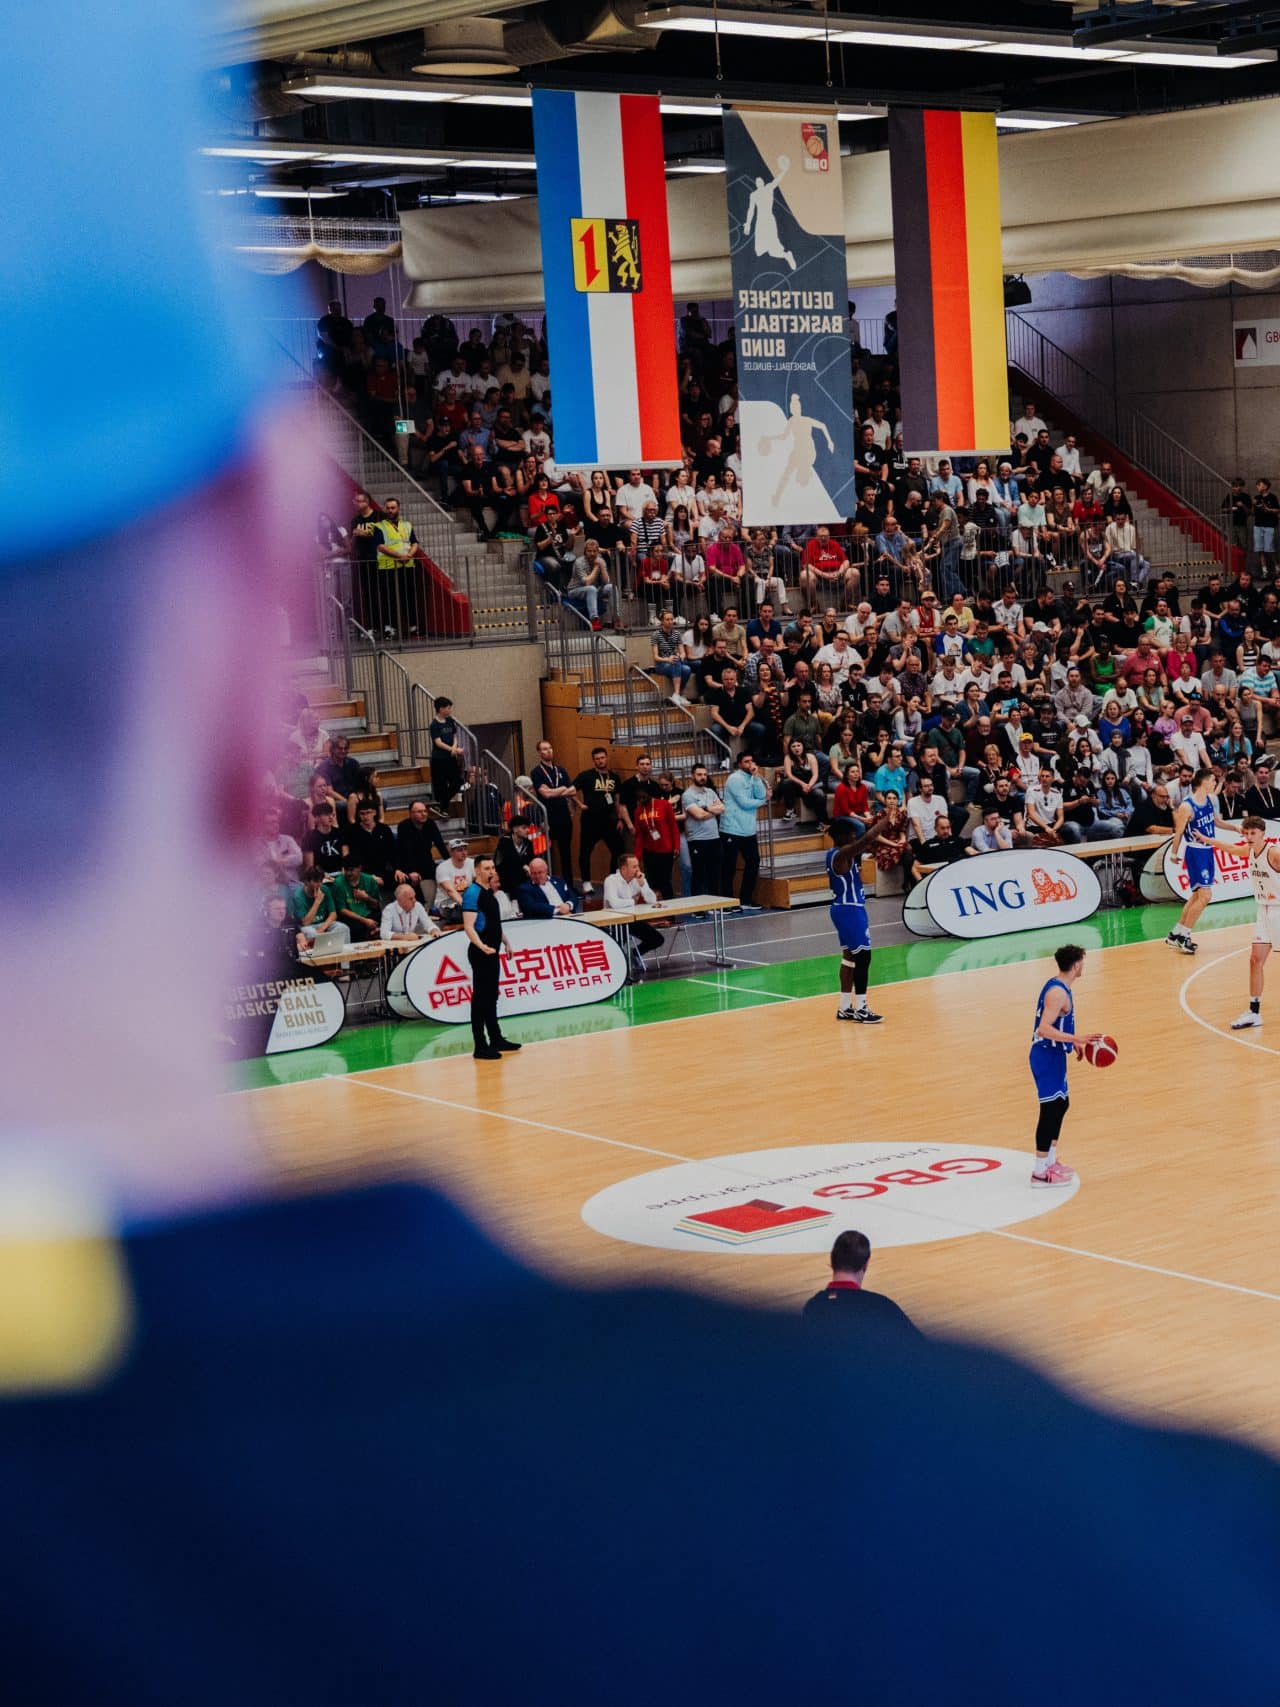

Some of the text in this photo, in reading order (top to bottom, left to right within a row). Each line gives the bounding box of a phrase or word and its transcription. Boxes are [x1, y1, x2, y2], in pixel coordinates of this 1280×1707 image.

[1222, 871, 1250, 883] PEA
[950, 879, 1026, 917] ING
[552, 973, 613, 991] SPORT
[283, 1010, 327, 1029] BUND
[645, 1146, 941, 1211] Unternehmensgruppe
[811, 1157, 1003, 1200] GBG
